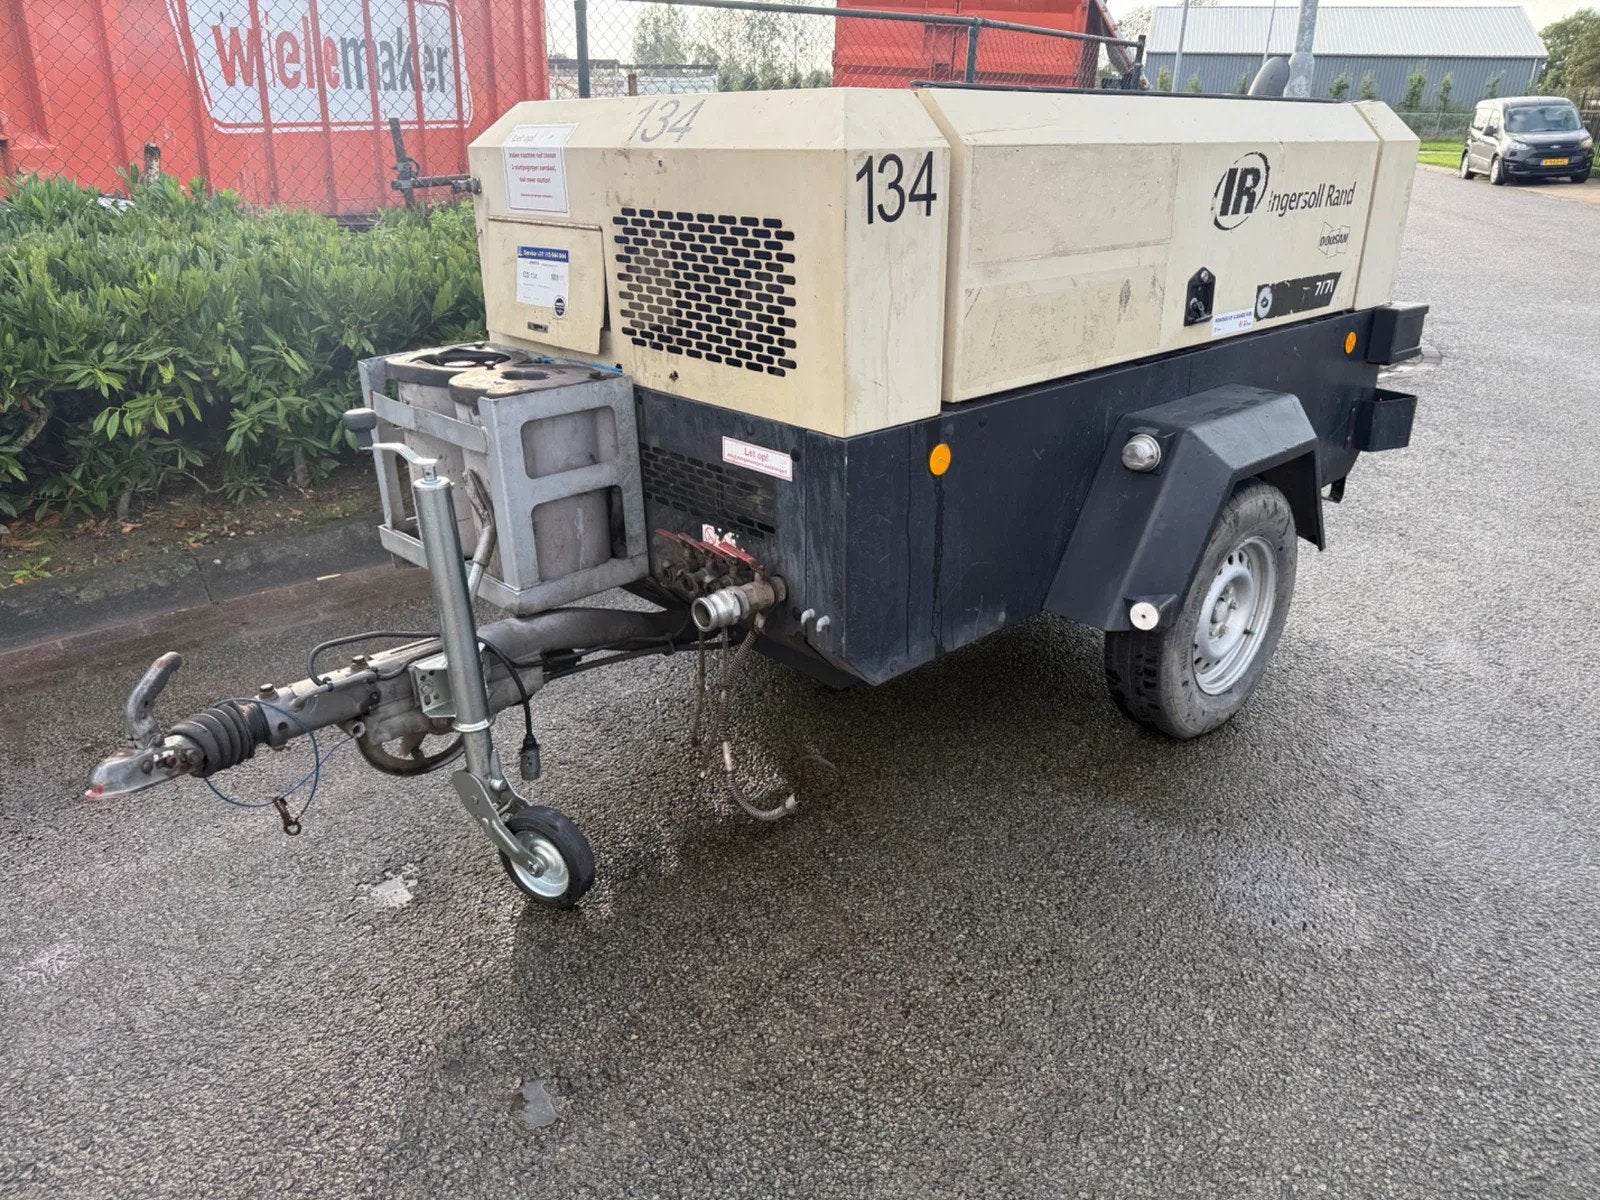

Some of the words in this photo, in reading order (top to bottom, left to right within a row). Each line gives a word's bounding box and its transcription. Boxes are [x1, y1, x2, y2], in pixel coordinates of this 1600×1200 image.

[211, 11, 449, 93] wielemaker
[627, 99, 706, 143] 134
[856, 151, 937, 224] 134
[1218, 167, 1261, 217] IR
[1267, 183, 1326, 218] Ingersoll
[1325, 181, 1357, 208] Rand
[744, 447, 756, 458] Let
